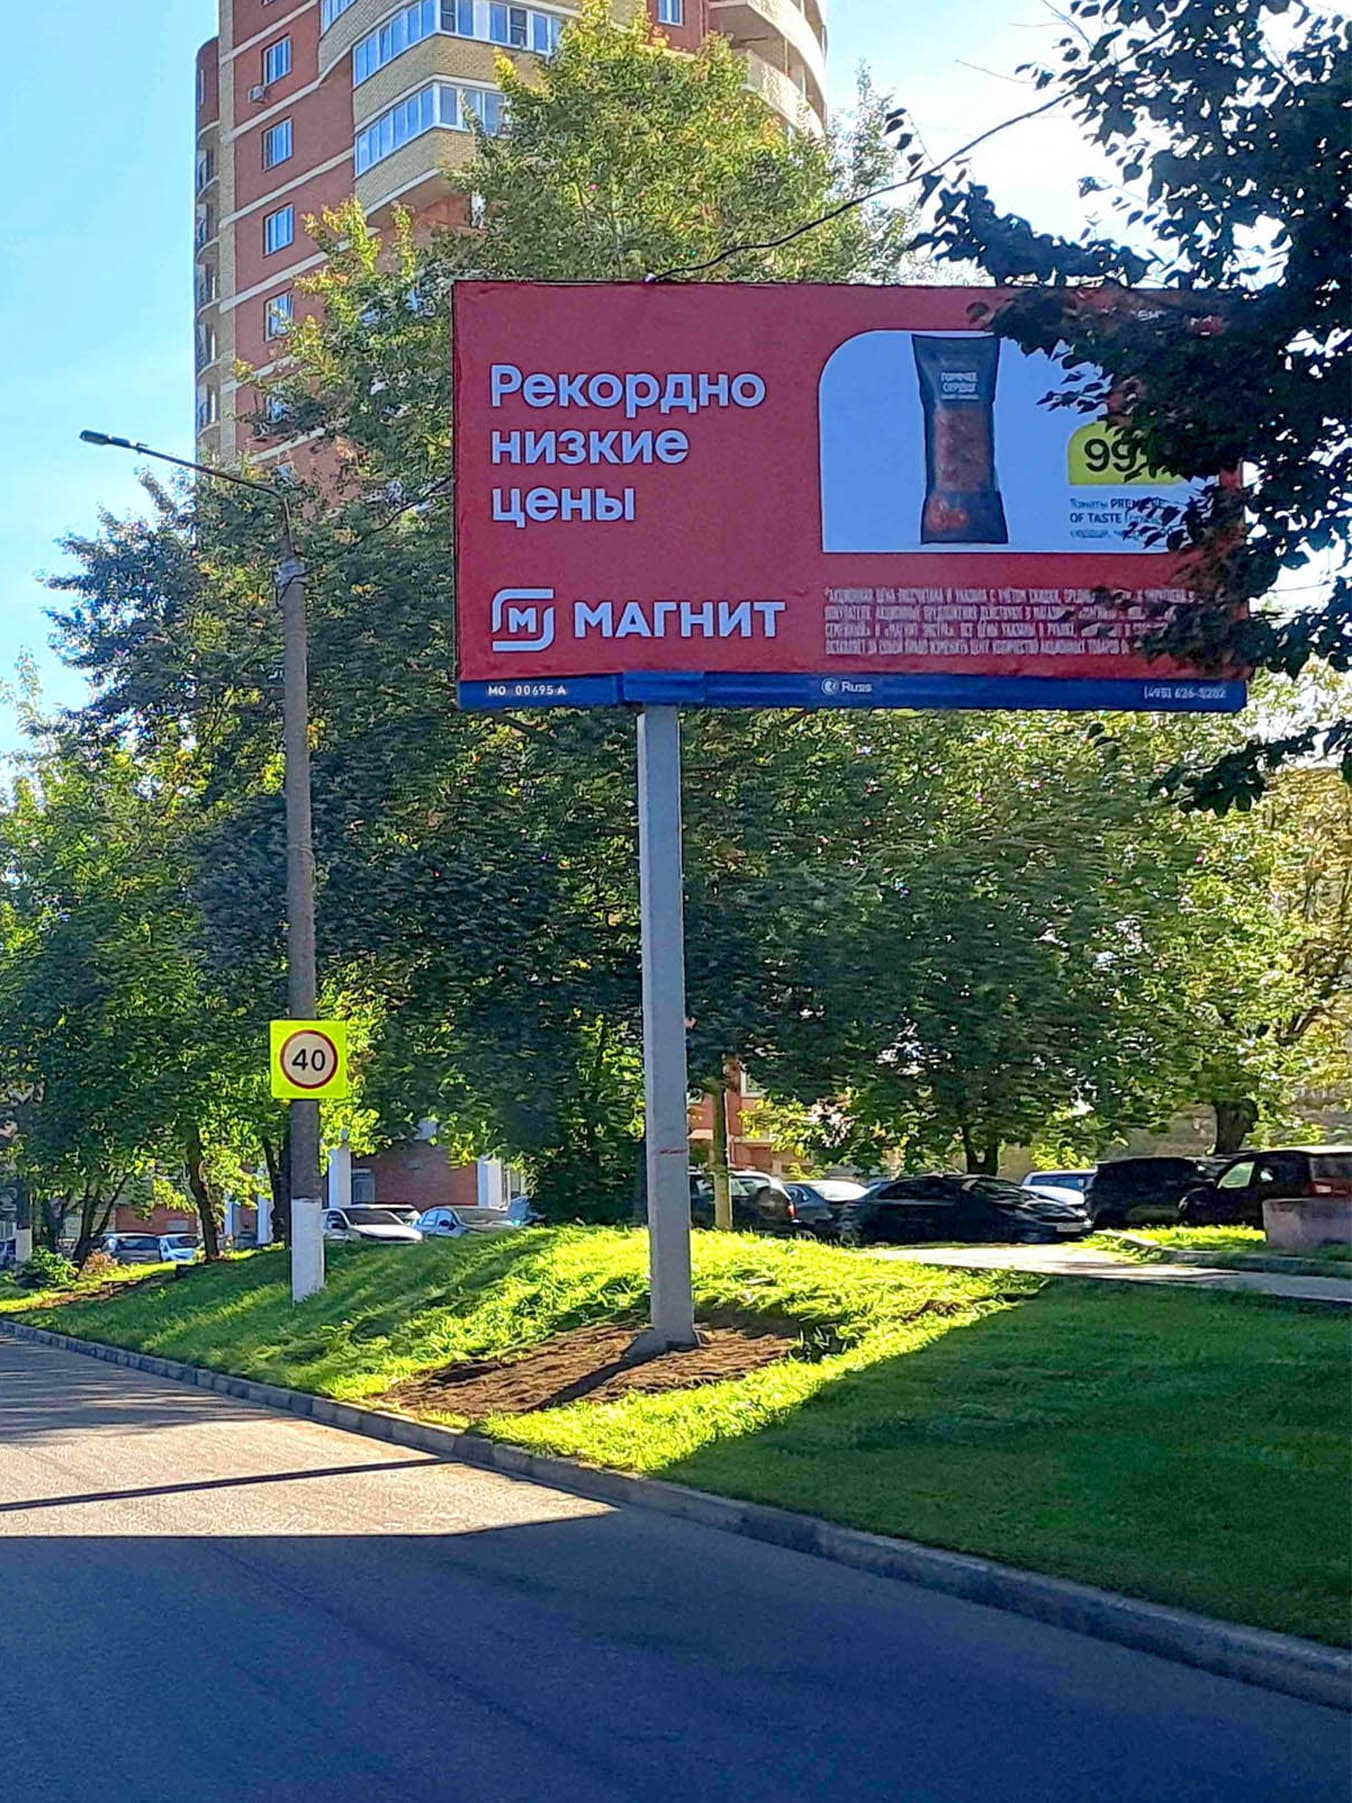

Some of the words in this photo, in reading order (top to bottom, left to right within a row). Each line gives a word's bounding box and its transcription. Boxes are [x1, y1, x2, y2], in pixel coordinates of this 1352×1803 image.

[490, 364, 766, 418] Рекордно
[491, 428, 689, 465] низкие
[492, 487, 635, 528] цены
[1070, 513, 1085, 523] OF
[1087, 512, 1122, 523] TASTE
[574, 601, 786, 638] МАГНИТ
[515, 684, 554, 696] 00695
[291, 1048, 326, 1071] 40
